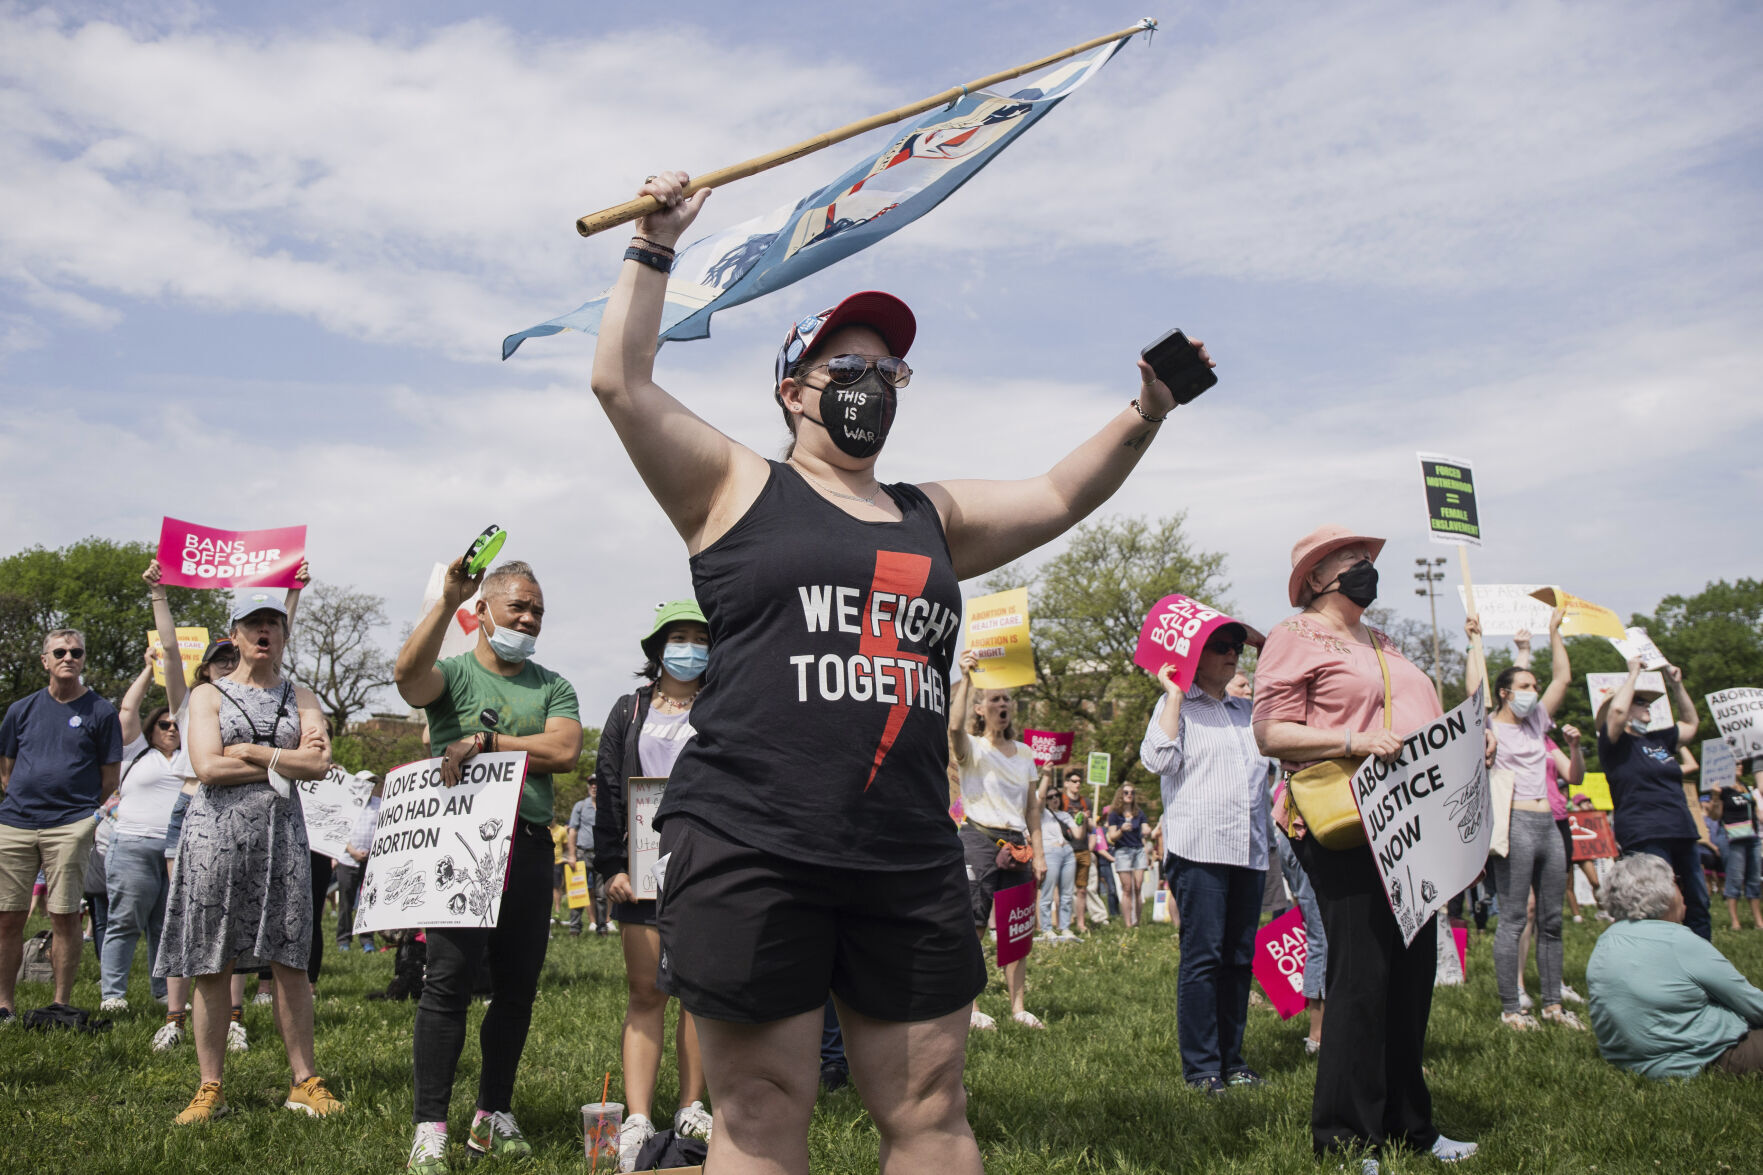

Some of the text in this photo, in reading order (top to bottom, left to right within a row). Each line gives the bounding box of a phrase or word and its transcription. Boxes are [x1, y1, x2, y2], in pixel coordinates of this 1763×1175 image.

[836, 390, 868, 405] THIS
[844, 407, 857, 421] IS
[843, 424, 876, 444] WAR
[1435, 465, 1461, 478] FORCED
[1426, 476, 1473, 493] MOTHERHOOD
[1440, 507, 1468, 520] FEMALE
[1431, 518, 1479, 536] ENSLAVEMENT
[185, 533, 245, 553] BANS
[182, 547, 280, 565] OFF OUR
[181, 560, 271, 579] BODIES
[798, 585, 959, 656] WE FIGHT
[971, 605, 1016, 621] ABORTION IS
[971, 615, 1022, 631] HEALTH CARE.
[1163, 606, 1195, 652] OFF
[970, 634, 1018, 648] ABORTION IS
[1175, 610, 1219, 658] BOD
[978, 647, 1005, 658] RIGHT.
[1717, 701, 1763, 720] JUSTICE
[1721, 717, 1753, 734] NOW
[1031, 735, 1056, 746] BANS
[1031, 743, 1067, 754] OFF OUR
[1032, 751, 1063, 761] BODIES
[383, 761, 516, 801] I LOVE SOEONE
[636, 783, 651, 792] MY
[636, 797, 650, 807] MY
[1368, 765, 1445, 841] JUSTICE
[377, 794, 474, 830] WHO HAD AN
[369, 827, 441, 860] ABORTION
[1378, 815, 1422, 877] NOW
[1578, 839, 1612, 856] BACK
[1266, 922, 1307, 960] BAN
